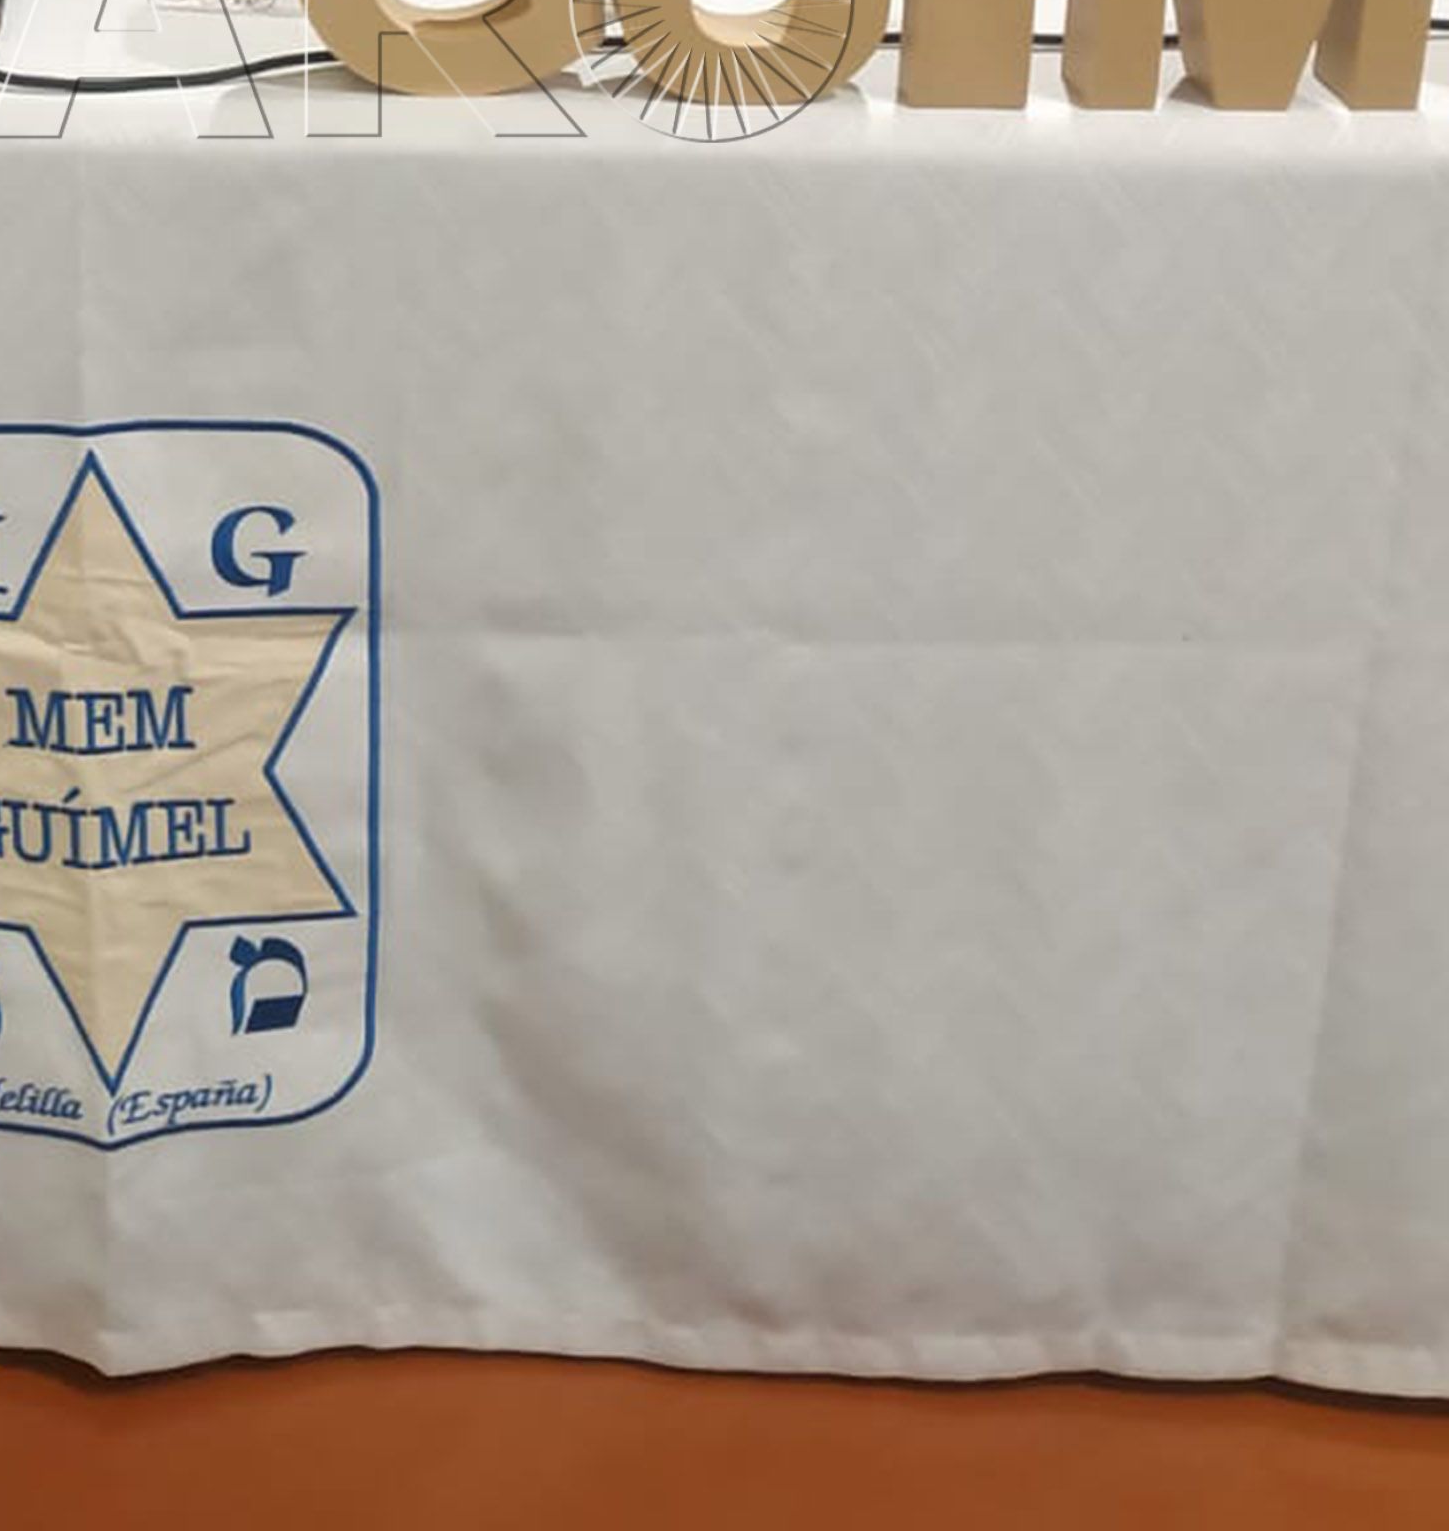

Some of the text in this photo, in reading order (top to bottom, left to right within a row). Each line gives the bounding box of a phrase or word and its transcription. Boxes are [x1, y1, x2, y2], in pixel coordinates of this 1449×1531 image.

[209, 505, 308, 597] G
[4, 686, 197, 756] MEM
[228, 935, 308, 1036] מ
[107, 1073, 273, 1136] (España)
